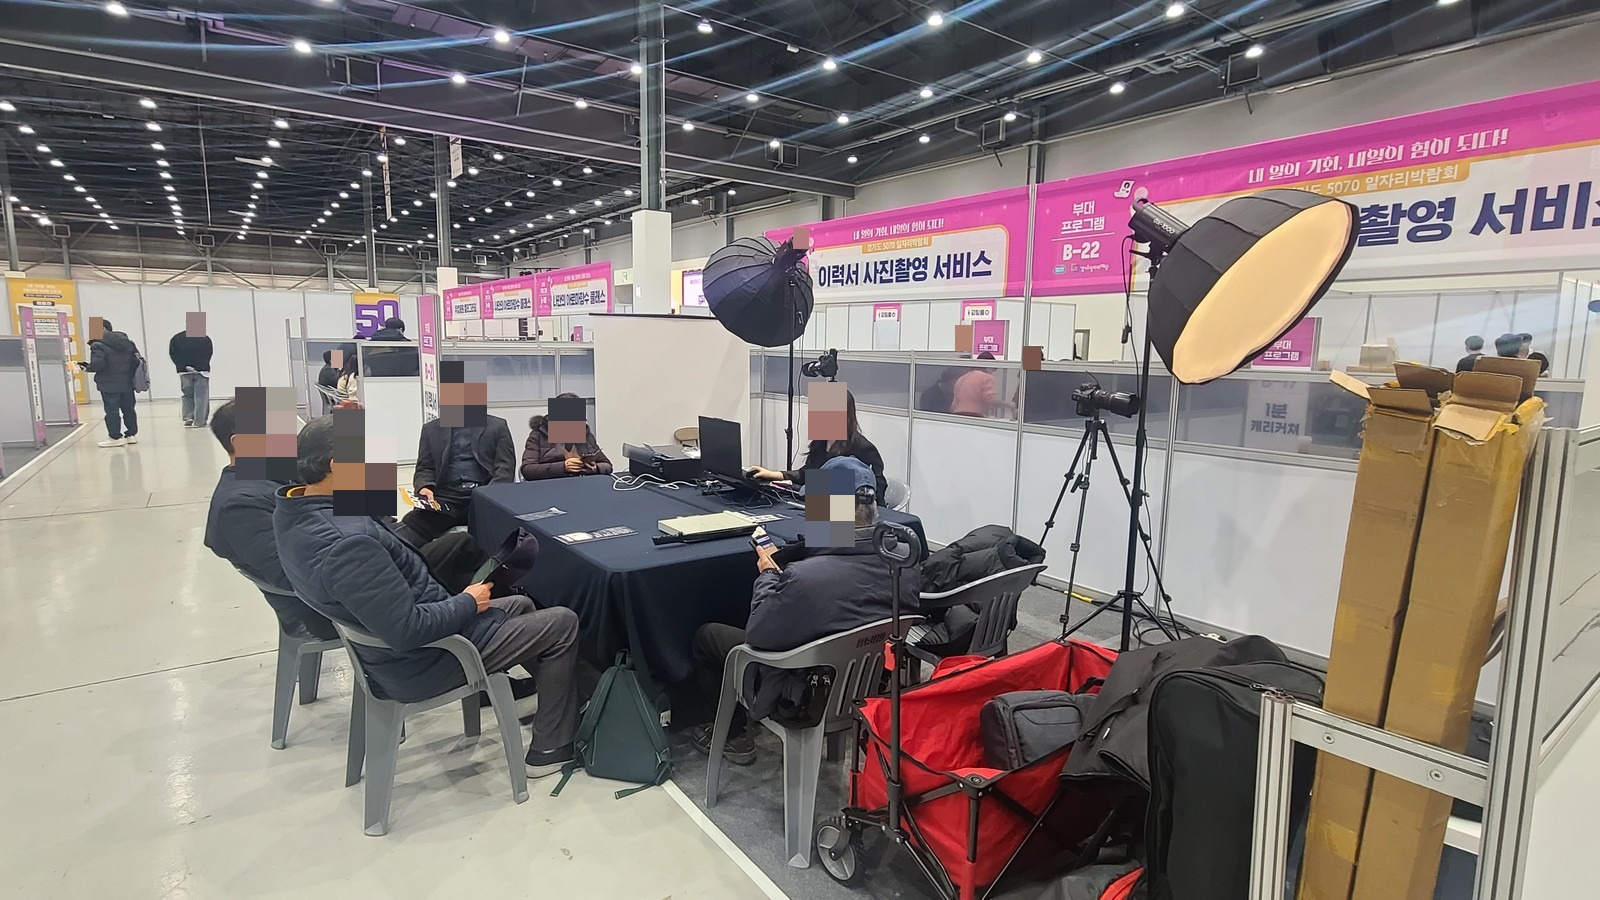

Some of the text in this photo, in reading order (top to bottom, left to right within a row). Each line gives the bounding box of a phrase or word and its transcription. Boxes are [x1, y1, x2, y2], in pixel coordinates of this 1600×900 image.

[1248, 127, 1509, 184] 내 일의 기회, 내일의 힘이 되다!
[1326, 180, 1360, 196] 5070
[1365, 164, 1459, 191] 일자리박람회
[1072, 200, 1095, 217] 부대
[1469, 181, 1600, 236] 서비
[1060, 216, 1105, 235] 프로그램
[1062, 240, 1100, 261] B-22
[818, 249, 993, 288] 이력서 사진촬영 서비스
[590, 289, 606, 305] 클래스
[1263, 351, 1300, 361] 프로그램
[1265, 402, 1288, 419] 1분
